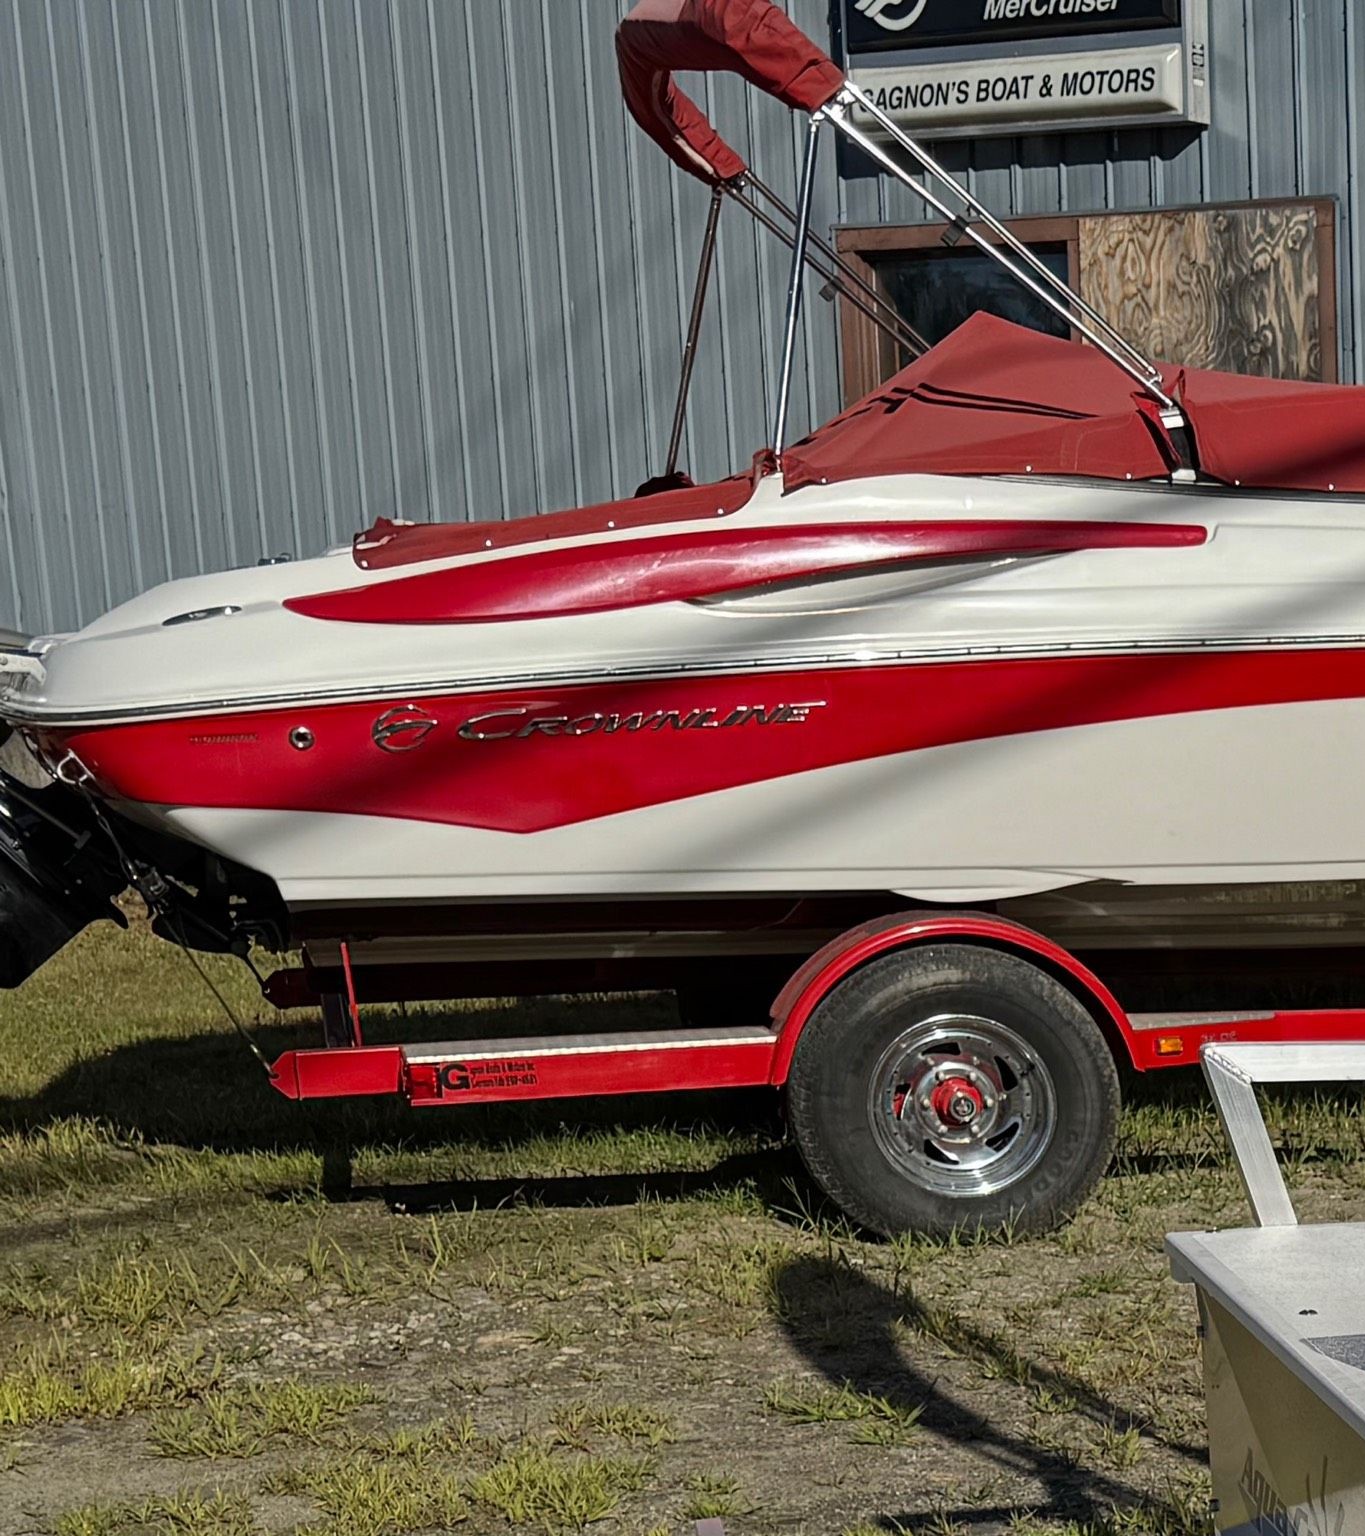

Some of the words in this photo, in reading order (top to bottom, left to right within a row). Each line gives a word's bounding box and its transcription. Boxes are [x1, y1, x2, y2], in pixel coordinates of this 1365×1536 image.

[976, 75, 1034, 103] BOAT
[1039, 75, 1053, 98] &
[1060, 67, 1156, 97] MOTORS
